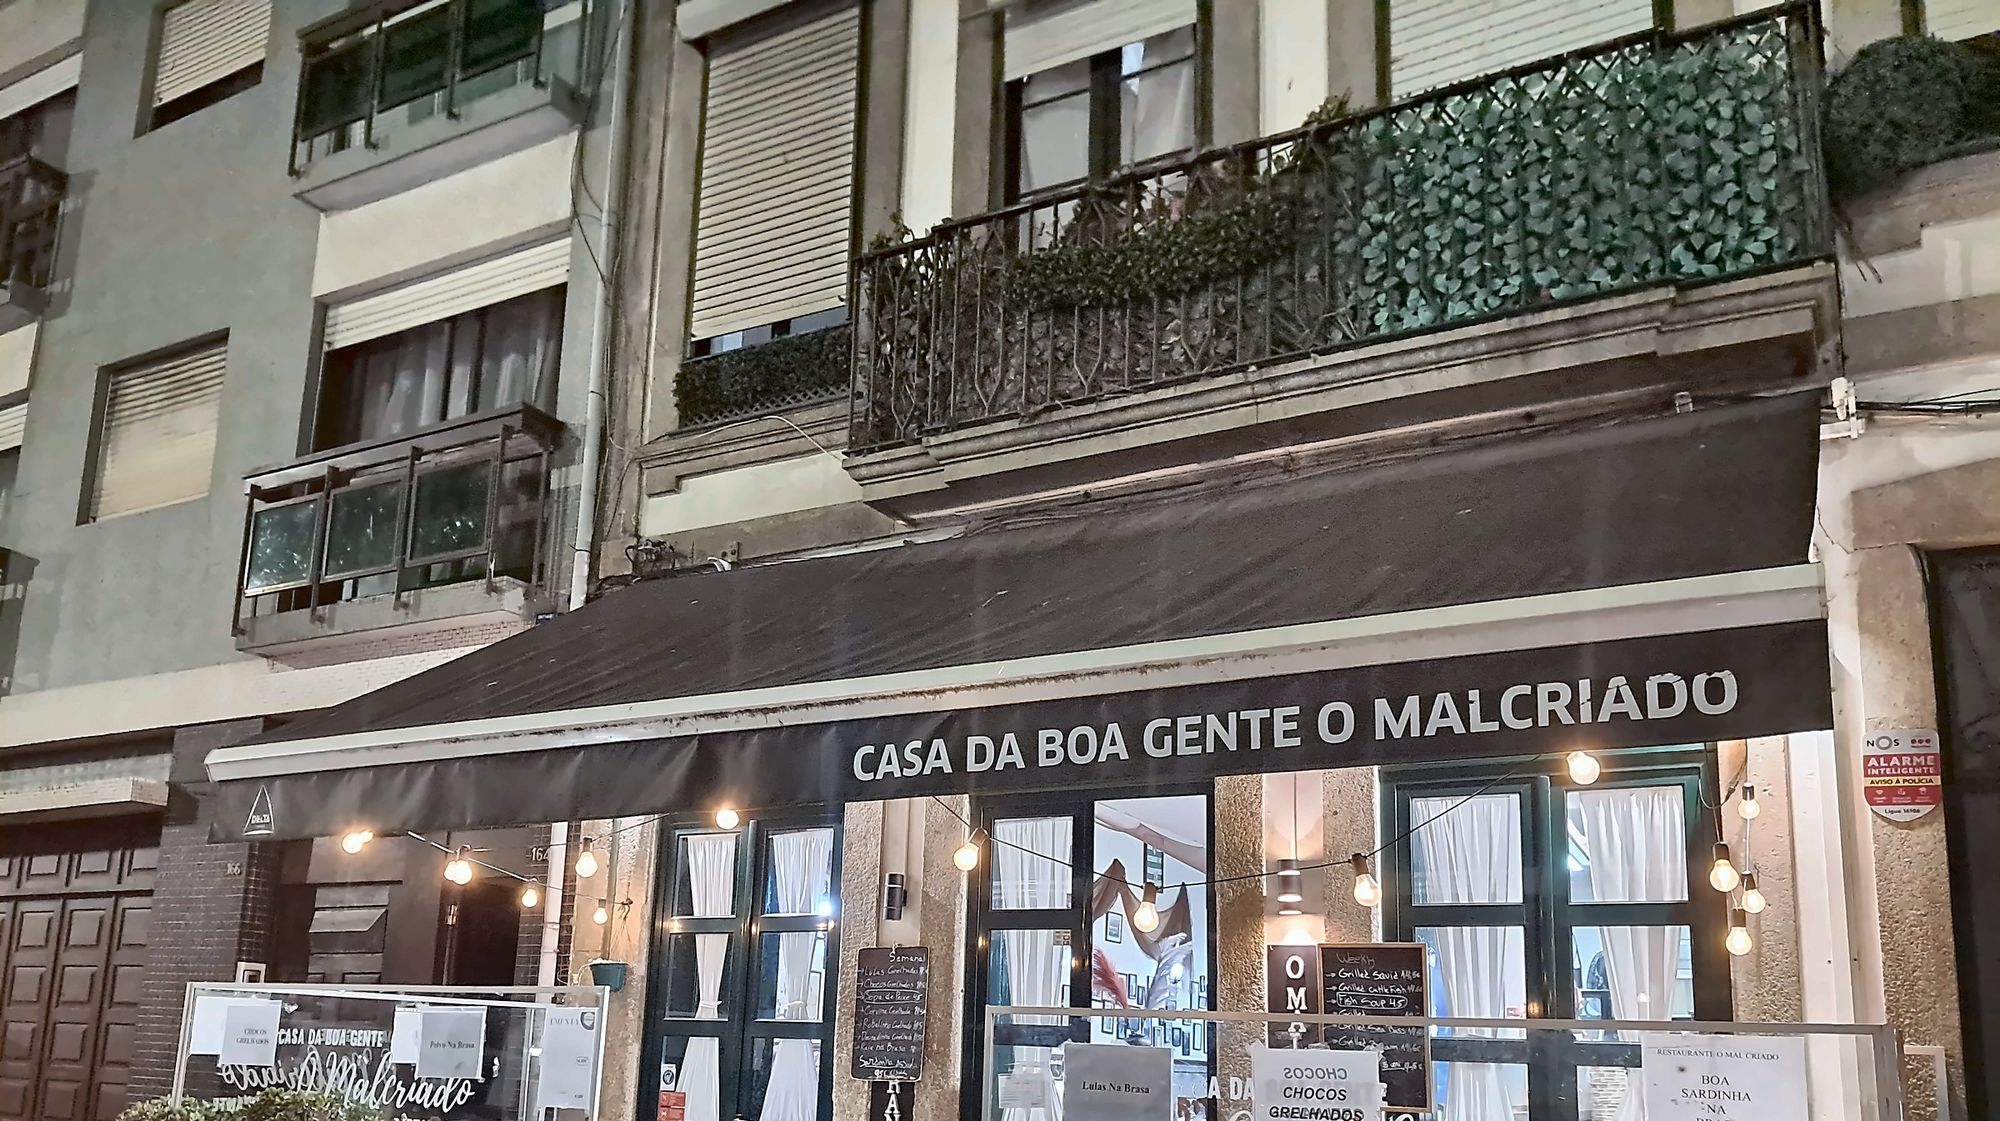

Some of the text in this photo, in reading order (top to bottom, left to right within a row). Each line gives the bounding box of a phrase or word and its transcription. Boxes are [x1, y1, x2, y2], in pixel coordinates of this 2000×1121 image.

[853, 669, 1739, 782] CASA DA BOA GENTE O MALCRIADO
[1866, 735, 1900, 750] NOS
[1868, 755, 1935, 767] ALARME
[1868, 767, 1934, 775] INTELIGENTE
[1336, 951, 1376, 969] Weekly
[1285, 955, 1304, 979] O
[1338, 968, 1370, 979] Grilled
[1338, 983, 1366, 992] Grilled
[1338, 994, 1358, 1005] Fish
[1361, 997, 1387, 1008] Soup
[279, 1028, 304, 1045] CASA
[349, 1030, 383, 1047] GENTE
[1338, 1036, 1366, 1047] Grilled
[1657, 1048, 1713, 1058] RESTAURANTE
[1725, 1051, 1743, 1059] MAL
[1701, 1075, 1730, 1086] BOA
[1082, 1081, 1150, 1094] Lulas Na Brasa
[1283, 1087, 1347, 1101] CHOCOS
[1681, 1088, 1752, 1102] SARDINHA
[1269, 1106, 1364, 1121] GRELHADOS
[1707, 1104, 1726, 1115] NA
